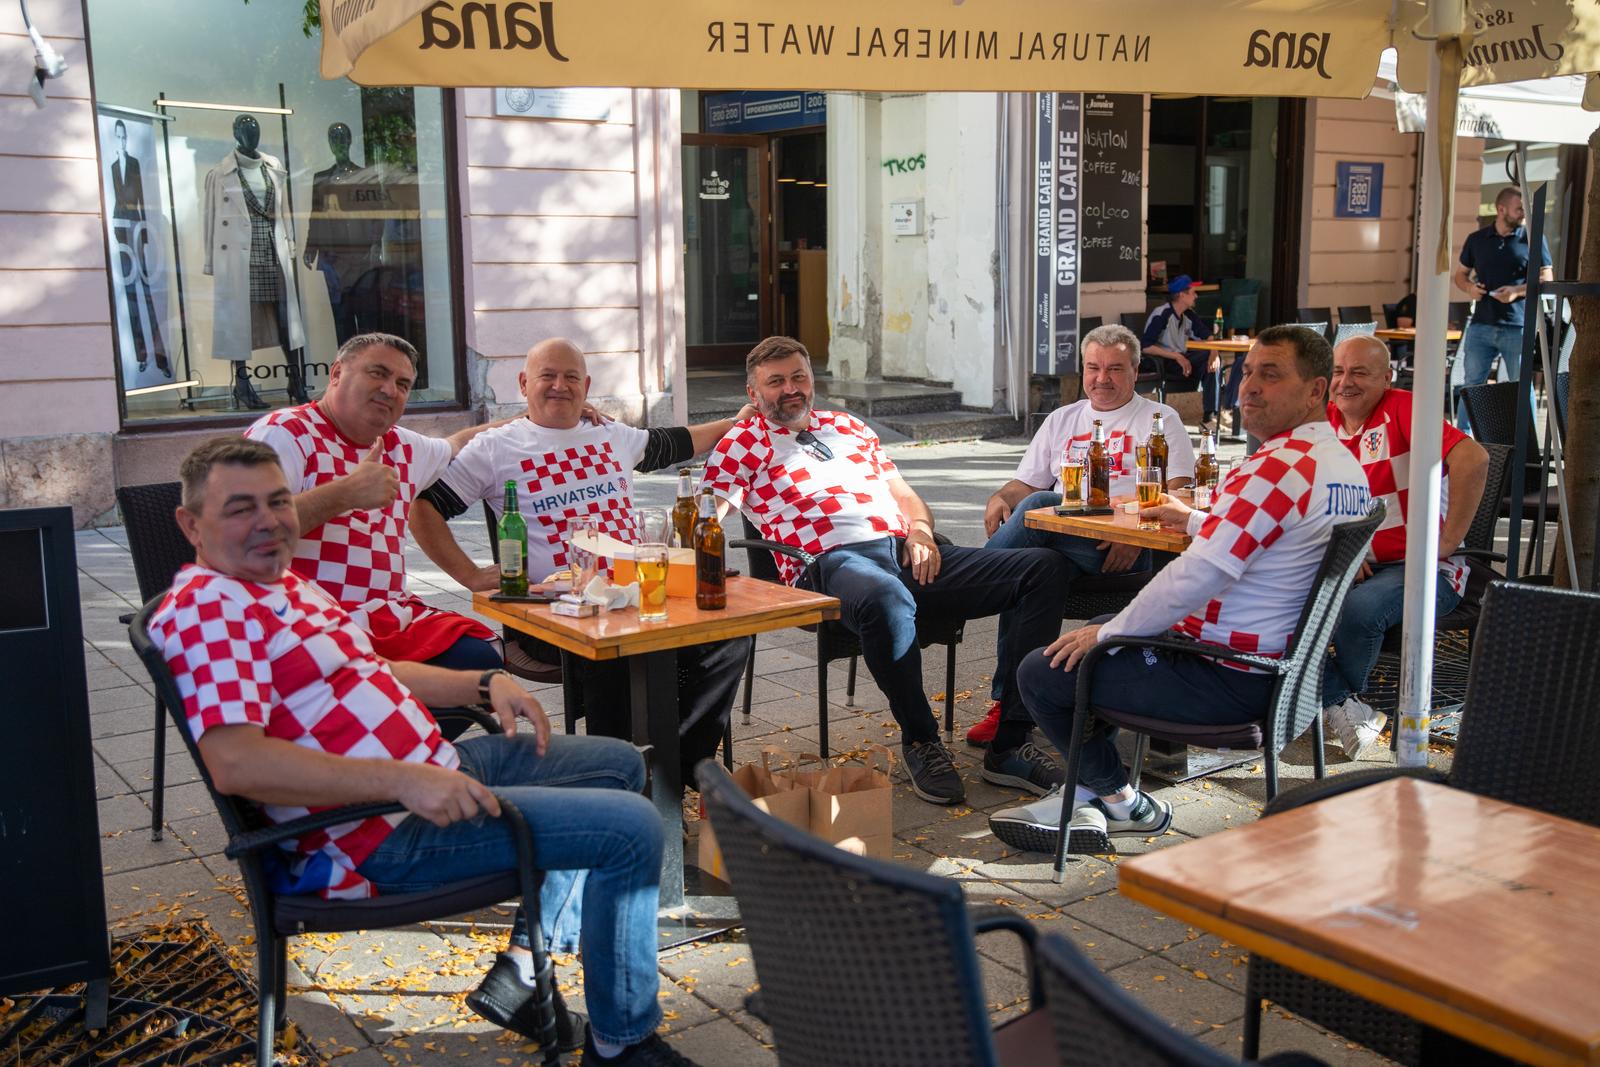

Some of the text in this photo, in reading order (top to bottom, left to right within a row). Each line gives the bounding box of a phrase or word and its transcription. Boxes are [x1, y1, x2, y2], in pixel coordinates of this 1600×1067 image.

[1351, 183, 1368, 194] 200
[1351, 194, 1367, 205] 200
[1038, 160, 1052, 257] GRAND CAFFE
[1058, 130, 1079, 286] GRAND CAFFE
[236, 362, 332, 380] comm
[532, 480, 618, 513] HRVATSKA
